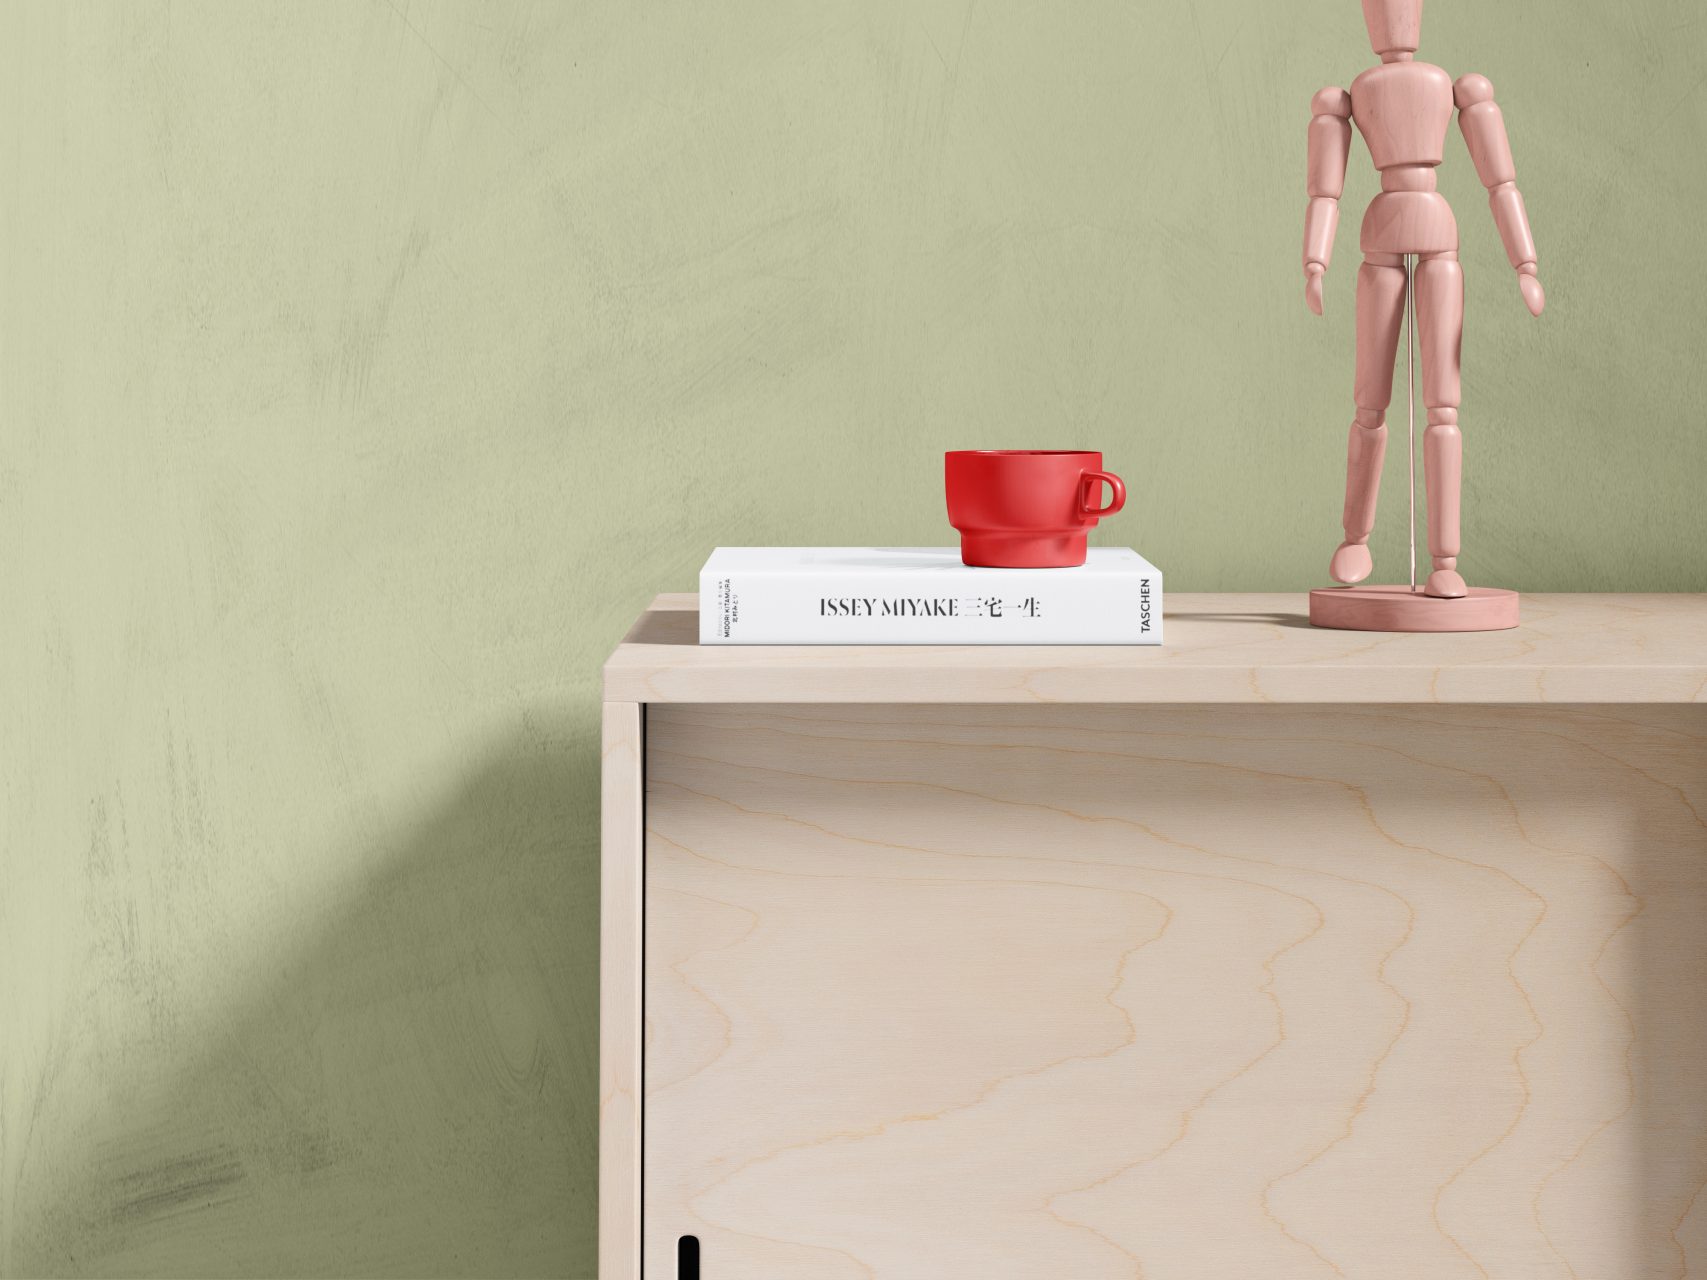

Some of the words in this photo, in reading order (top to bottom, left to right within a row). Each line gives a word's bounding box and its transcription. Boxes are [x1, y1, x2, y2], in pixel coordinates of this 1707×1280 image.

[820, 598, 877, 616] ISSEY
[881, 598, 959, 616] MIYAKE
[1140, 578, 1150, 634] TASCHEN
